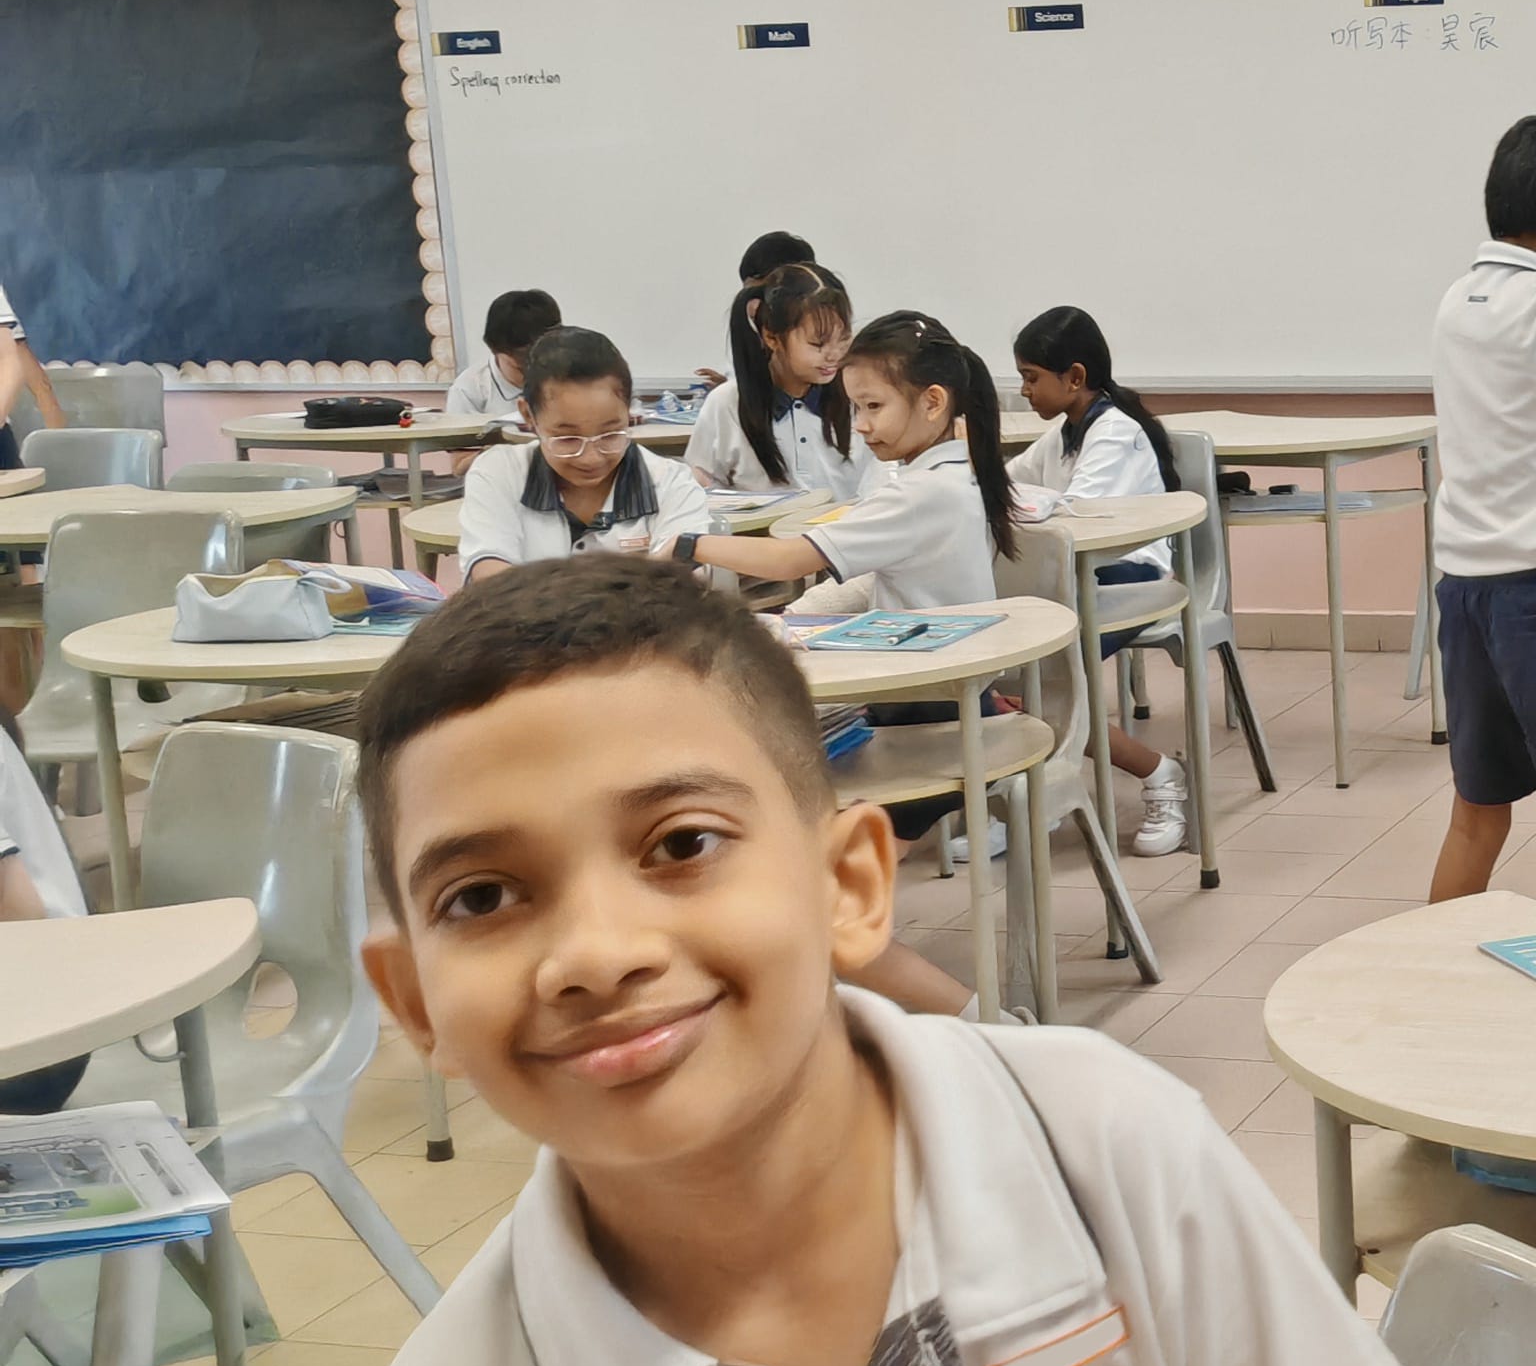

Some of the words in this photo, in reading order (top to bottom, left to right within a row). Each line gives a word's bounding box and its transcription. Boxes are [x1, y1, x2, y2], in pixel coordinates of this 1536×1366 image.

[1034, 11, 1074, 23] Science
[768, 31, 796, 42] Math
[456, 38, 492, 50] English
